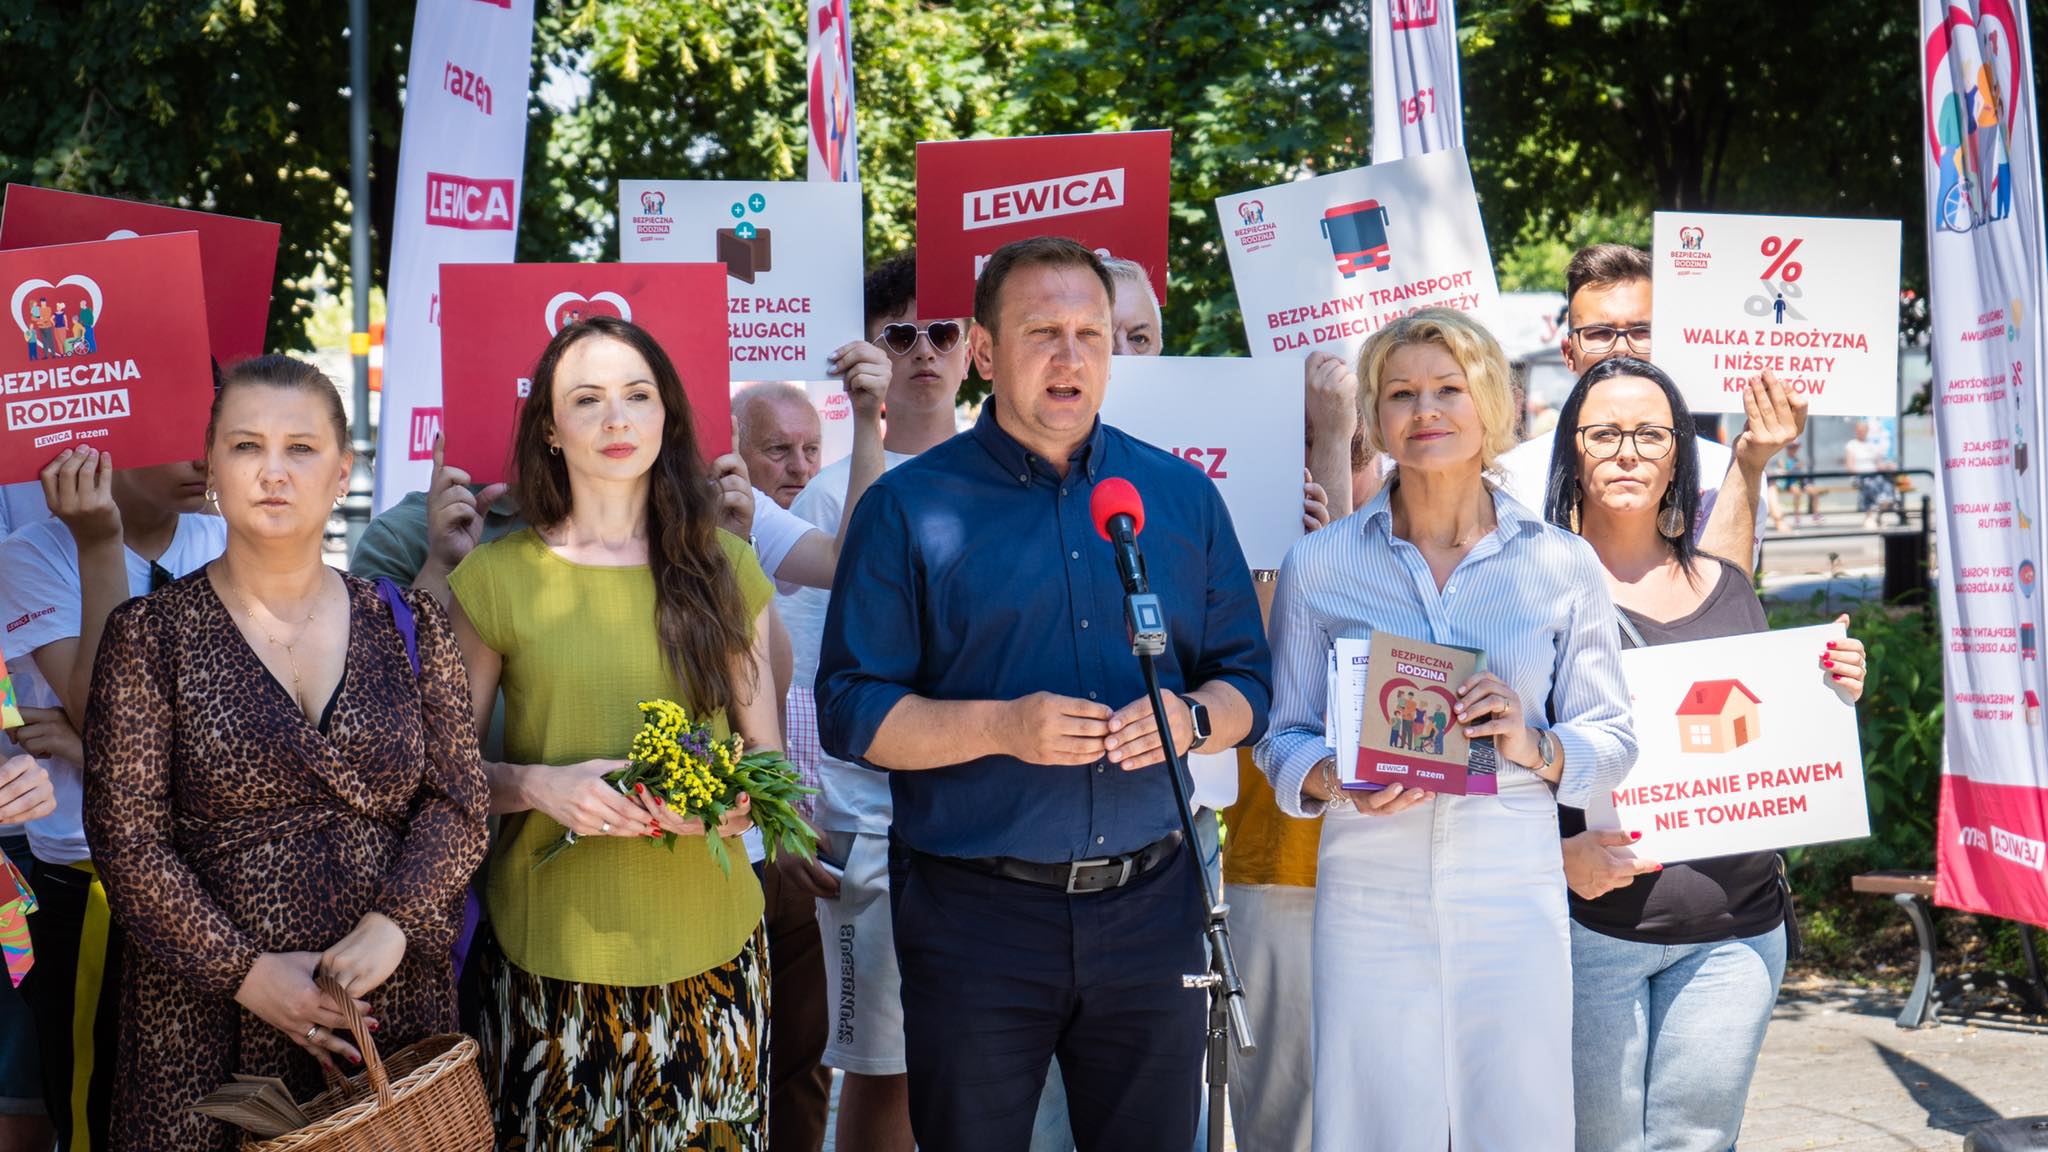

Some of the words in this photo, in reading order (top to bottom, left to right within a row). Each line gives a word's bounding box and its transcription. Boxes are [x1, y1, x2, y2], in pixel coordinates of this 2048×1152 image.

[973, 176, 1116, 223] LEWICA
[755, 297, 811, 313] PŁACE
[1267, 294, 1365, 329] BEZPŁATNY
[1369, 270, 1473, 306] TRANSPORT
[1272, 333, 1310, 352] DLA
[1313, 317, 1370, 344] DZIECI
[1374, 316, 1380, 331] I
[1683, 328, 1749, 345] WALKA
[1755, 330, 1765, 345] Z
[1770, 328, 1868, 353] DROŻYZNĄ
[1714, 354, 1719, 370] I
[1725, 351, 1784, 371] NIŻSZE
[1790, 356, 1835, 372] RATY
[11, 393, 126, 426] RODZINA
[36, 431, 71, 447] LEWICA
[76, 428, 109, 440] razem
[31, 606, 56, 620] azem
[1391, 648, 1454, 671] BEZPIECZNA
[1397, 662, 1446, 682] RODZINA
[1377, 763, 1407, 773] LEWICA
[1416, 769, 1445, 780] razem
[1611, 774, 1741, 808] MIESZKANIE
[1746, 761, 1844, 790] PRAWEM
[1655, 810, 1690, 832] NIE
[1694, 794, 1808, 826] TOWAREM
